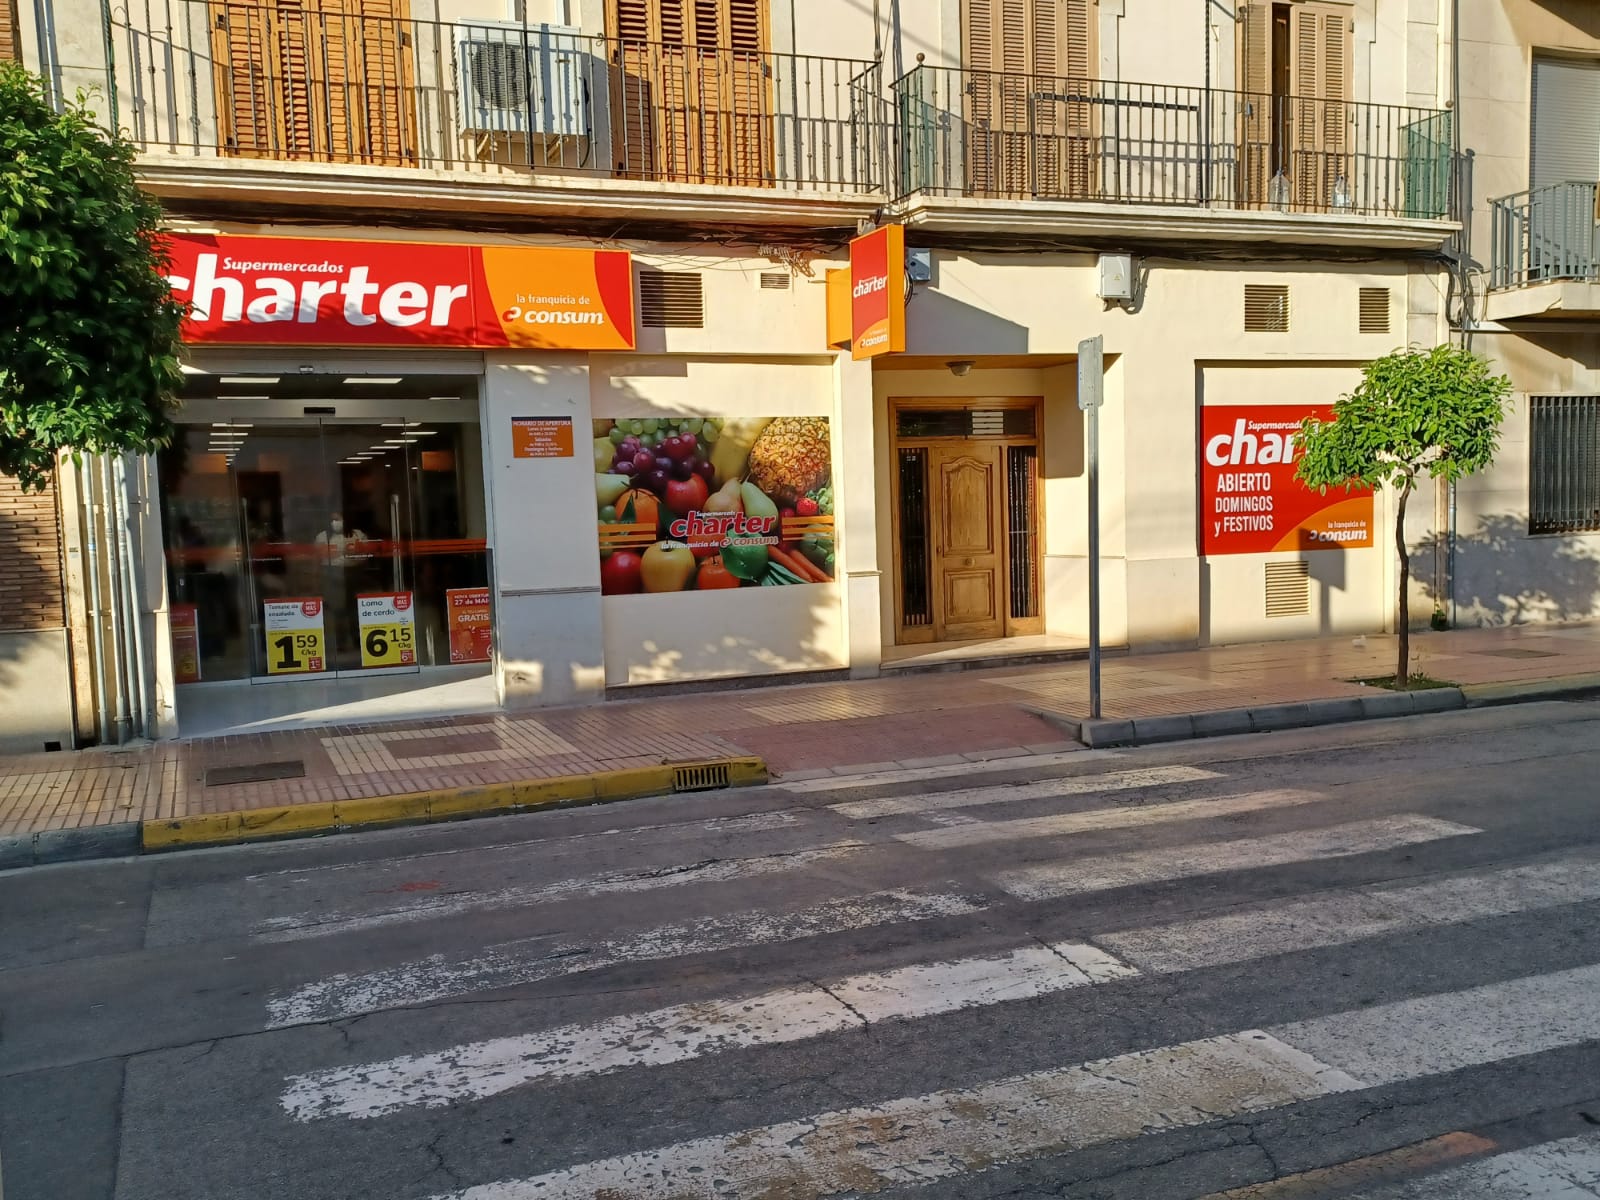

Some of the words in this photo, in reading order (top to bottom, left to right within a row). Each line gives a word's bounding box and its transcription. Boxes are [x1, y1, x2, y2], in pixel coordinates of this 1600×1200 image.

[223, 257, 344, 274] Supermercados
[853, 276, 888, 298] charter
[516, 294, 526, 303] la
[528, 294, 576, 306] franquicia
[578, 296, 590, 304] de
[524, 310, 604, 325] consum
[1248, 420, 1303, 432] Supermercad
[1206, 418, 1312, 466] char
[1217, 472, 1270, 492] ABIERTO
[1216, 496, 1274, 513] DOMINGOS
[670, 510, 776, 537] charter
[1214, 522, 1220, 538] y
[1224, 514, 1274, 532] FESTIVOS
[1334, 521, 1358, 529] franquicia
[670, 540, 708, 550] franquicia
[733, 536, 778, 546] consum
[1318, 530, 1368, 542] consum
[458, 613, 489, 621] GRATIS
[366, 630, 388, 657] 6
[390, 628, 411, 642] 15
[275, 636, 302, 668] 1
[296, 635, 317, 648] 59
